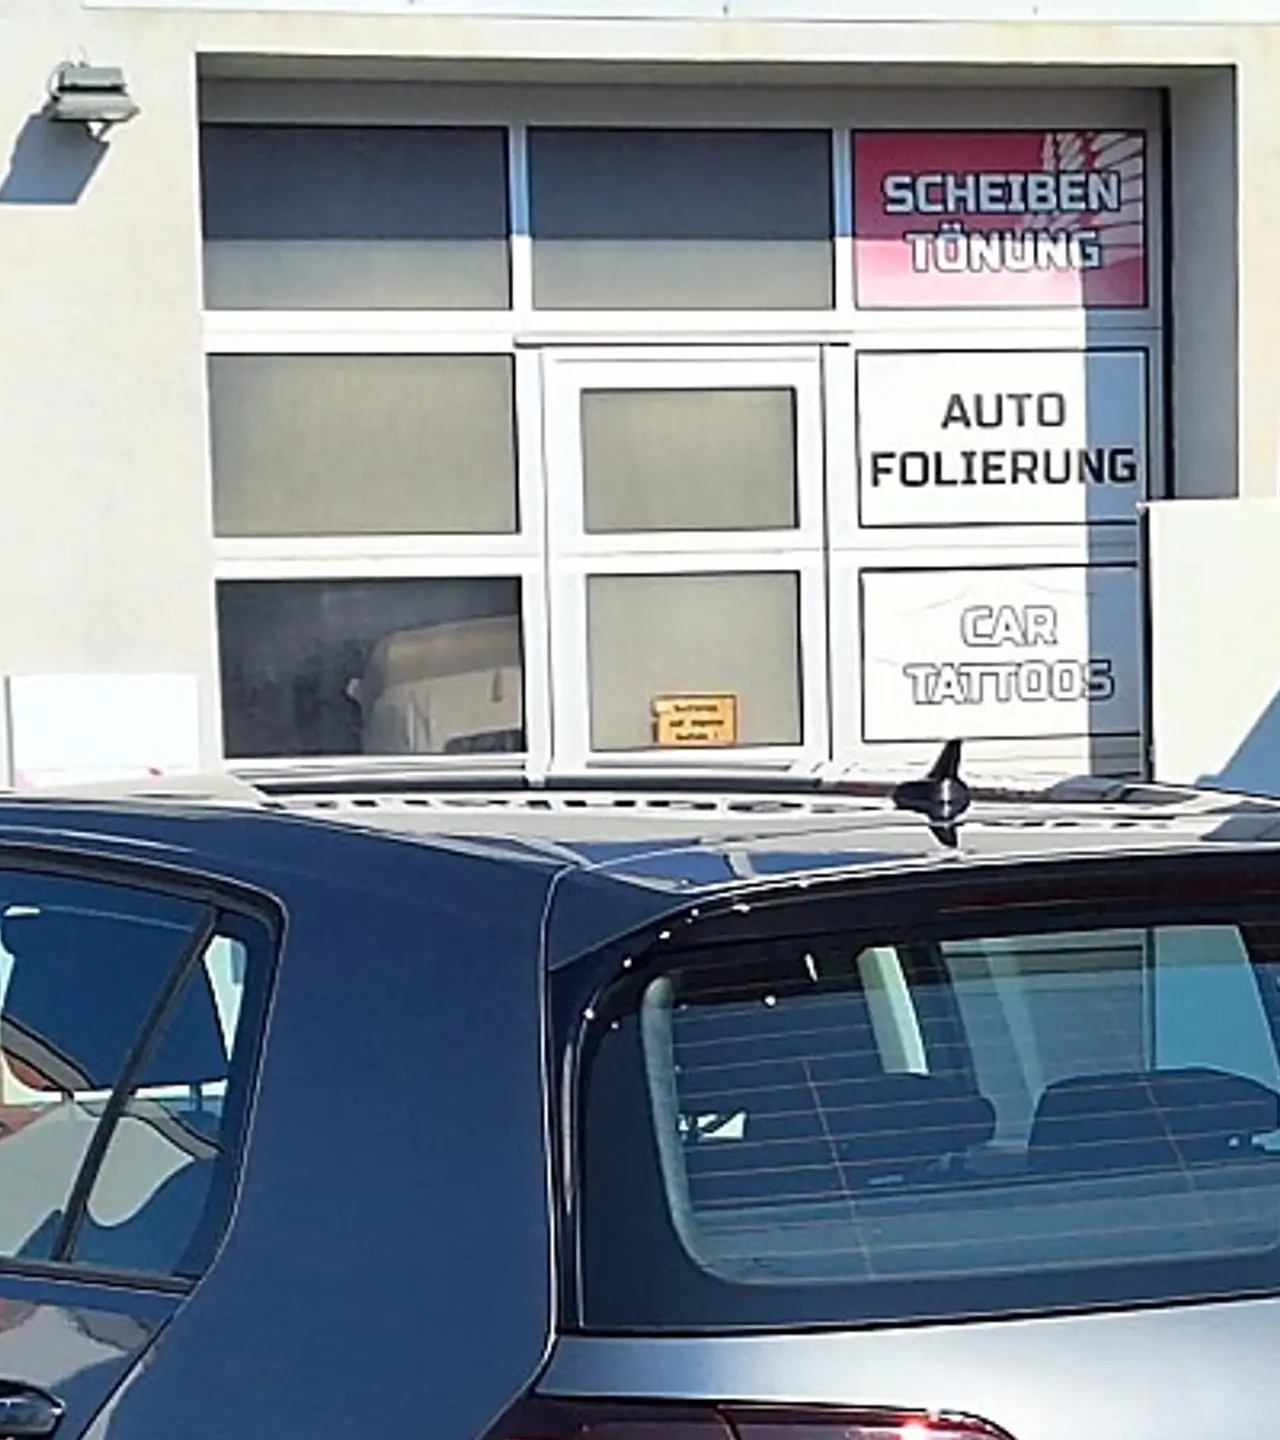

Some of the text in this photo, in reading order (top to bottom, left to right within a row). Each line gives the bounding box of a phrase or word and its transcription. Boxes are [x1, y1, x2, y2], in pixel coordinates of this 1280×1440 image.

[883, 172, 1121, 214] SCHEIBEN
[905, 220, 1103, 271] TÖNUNG
[941, 392, 1066, 430] AUTO
[871, 448, 1138, 488] FOLIERUNG
[960, 604, 1059, 648] CAR
[903, 658, 1116, 705] TATTOOS
